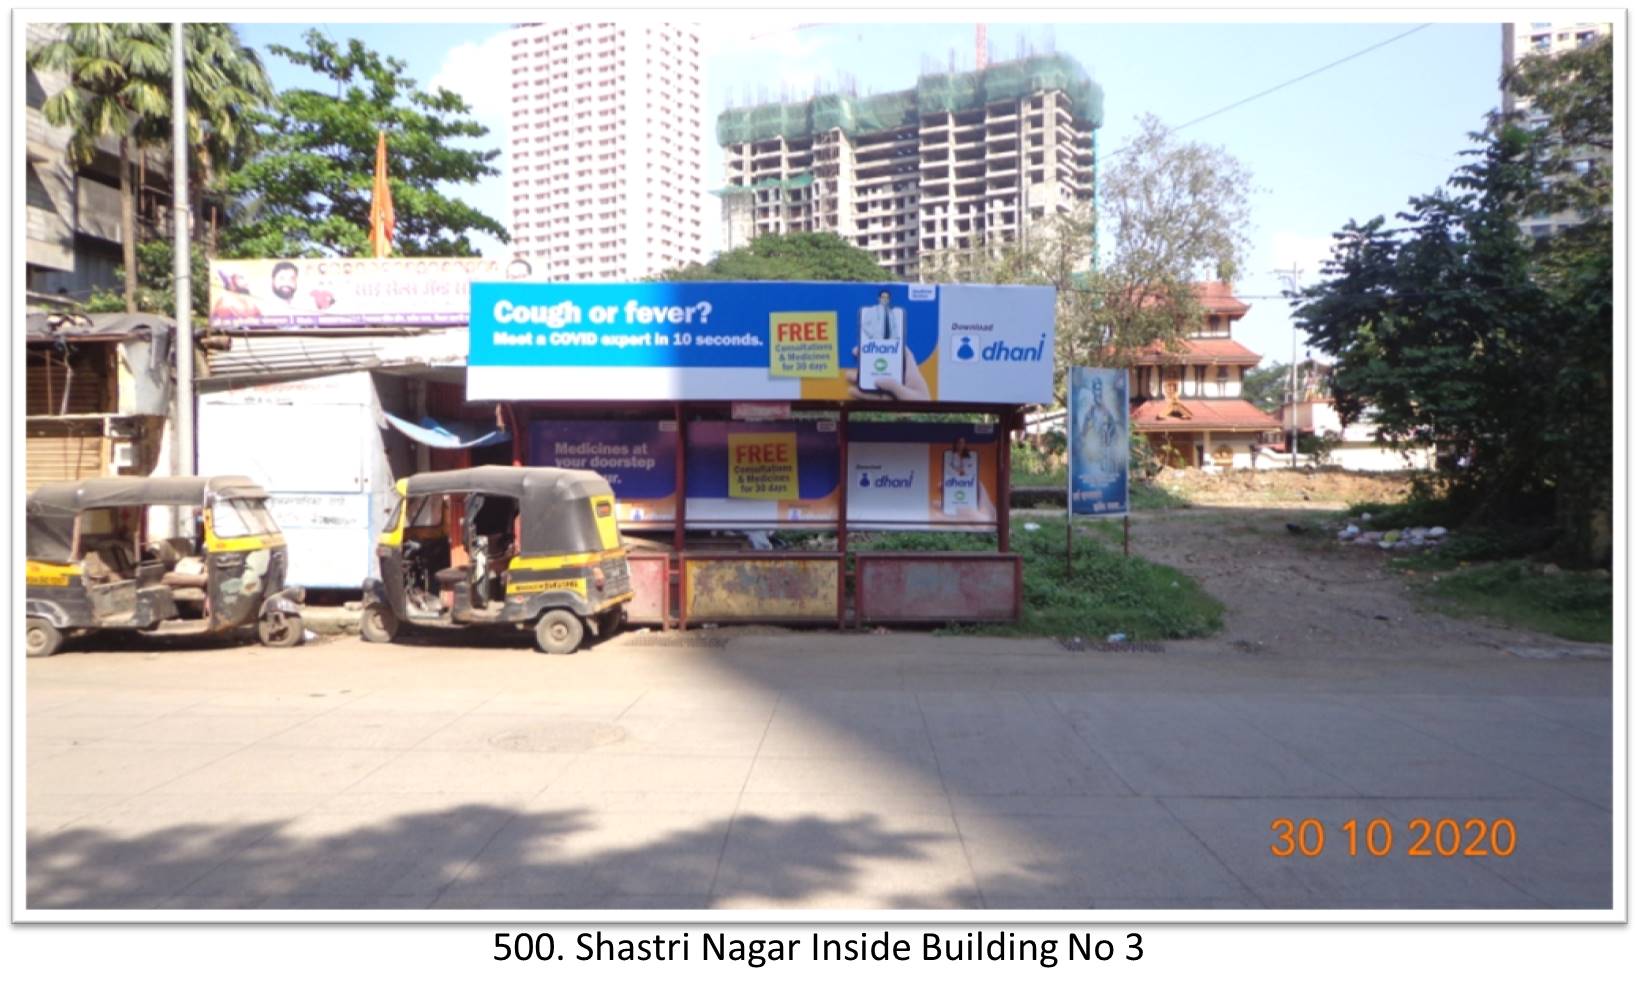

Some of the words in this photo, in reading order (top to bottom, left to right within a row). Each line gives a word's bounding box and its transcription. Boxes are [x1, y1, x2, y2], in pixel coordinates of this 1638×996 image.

[493, 300, 581, 328] Cough
[589, 305, 618, 324] or
[624, 300, 712, 324] fever?
[777, 321, 829, 342] FREE
[952, 323, 994, 331] Download
[493, 333, 532, 346] Meet
[537, 336, 546, 346] a
[550, 333, 597, 346] COVID
[601, 334, 650, 348] expert
[654, 333, 669, 346] in
[673, 333, 690, 346] 10
[696, 333, 763, 346] seconds.
[862, 342, 899, 354] dhani
[981, 333, 1046, 361] dhani
[554, 442, 628, 455] Medicines
[632, 443, 648, 455] at
[736, 443, 788, 463] FREE
[555, 457, 586, 468] your
[589, 456, 655, 470] doorstep
[875, 470, 914, 488] dhani
[945, 475, 975, 487] dhani
